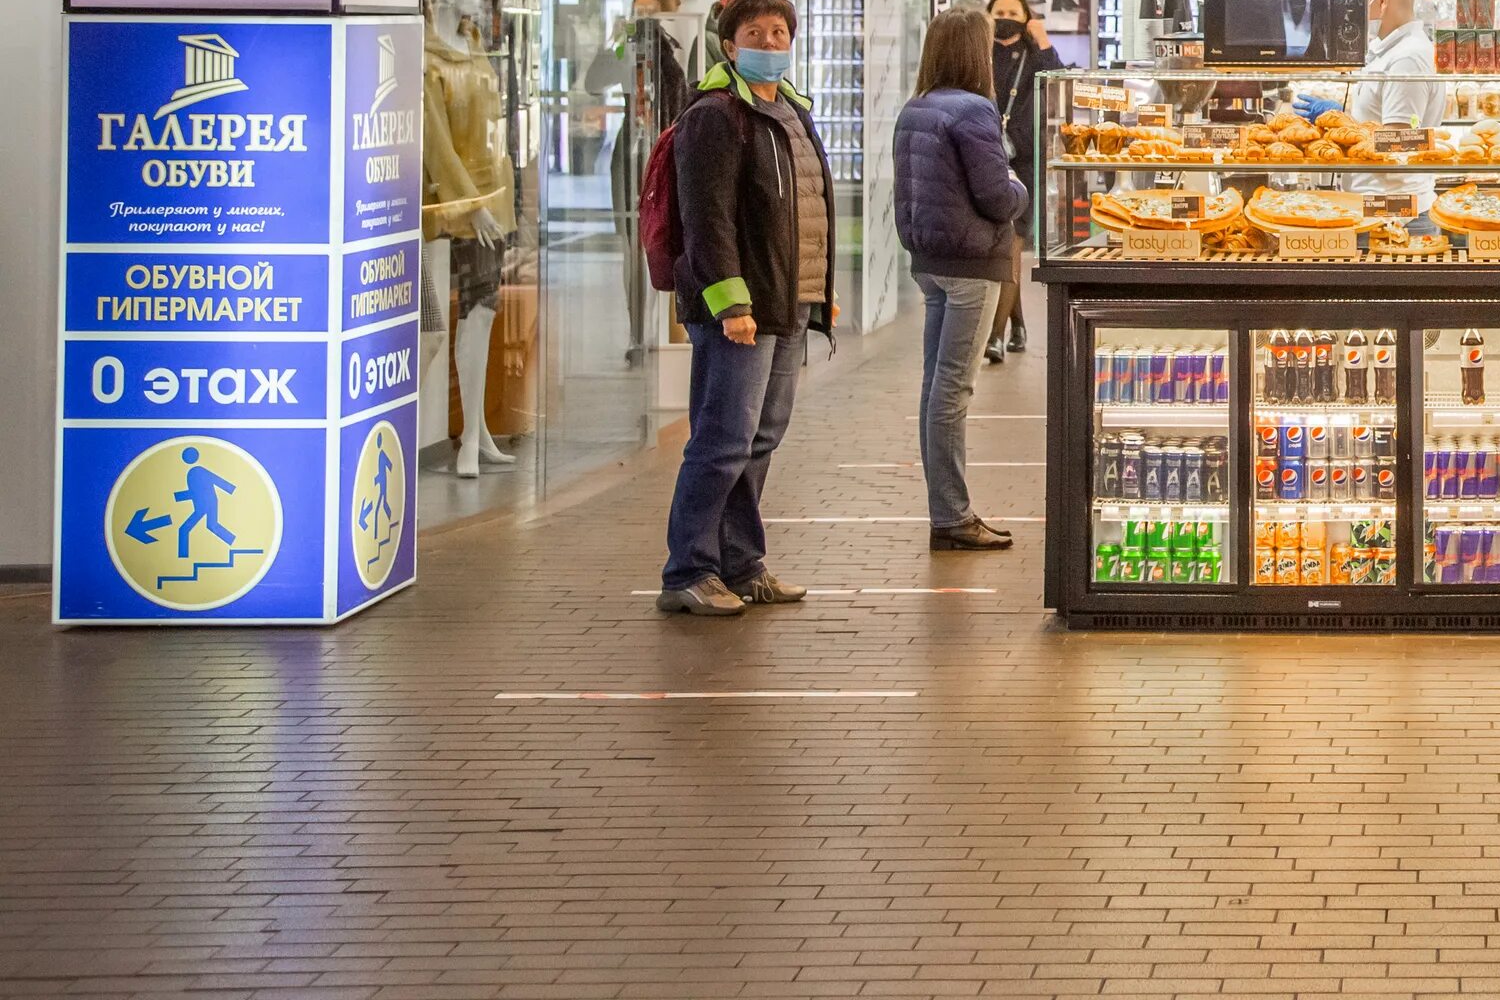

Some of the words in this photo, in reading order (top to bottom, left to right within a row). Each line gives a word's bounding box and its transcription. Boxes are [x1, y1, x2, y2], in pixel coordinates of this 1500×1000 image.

[98, 113, 308, 152] ГАЛЕРЕЯ
[353, 110, 415, 150] ГАЛЕРЕЯ
[142, 159, 255, 188] ОБУВИ
[366, 155, 400, 184] ОБУВИ
[109, 202, 208, 219] Примеряют
[213, 206, 222, 218] у
[227, 204, 286, 218] многих,
[128, 222, 211, 236] покупают
[217, 222, 227, 236] у
[232, 220, 265, 233] нас!
[1129, 235, 1193, 252] tastylab
[1285, 234, 1349, 253] tastylab
[126, 262, 274, 290] ОБУВНОЙ
[360, 250, 405, 285] ОБУВНОЙ
[97, 297, 302, 322] ГИПЕРМАРКЕТ
[351, 281, 413, 319] ГИПЕРМАРКЕТ
[91, 355, 125, 404] 0
[143, 367, 299, 405] этаж
[349, 352, 361, 400] 0
[365, 348, 411, 387] этаж
